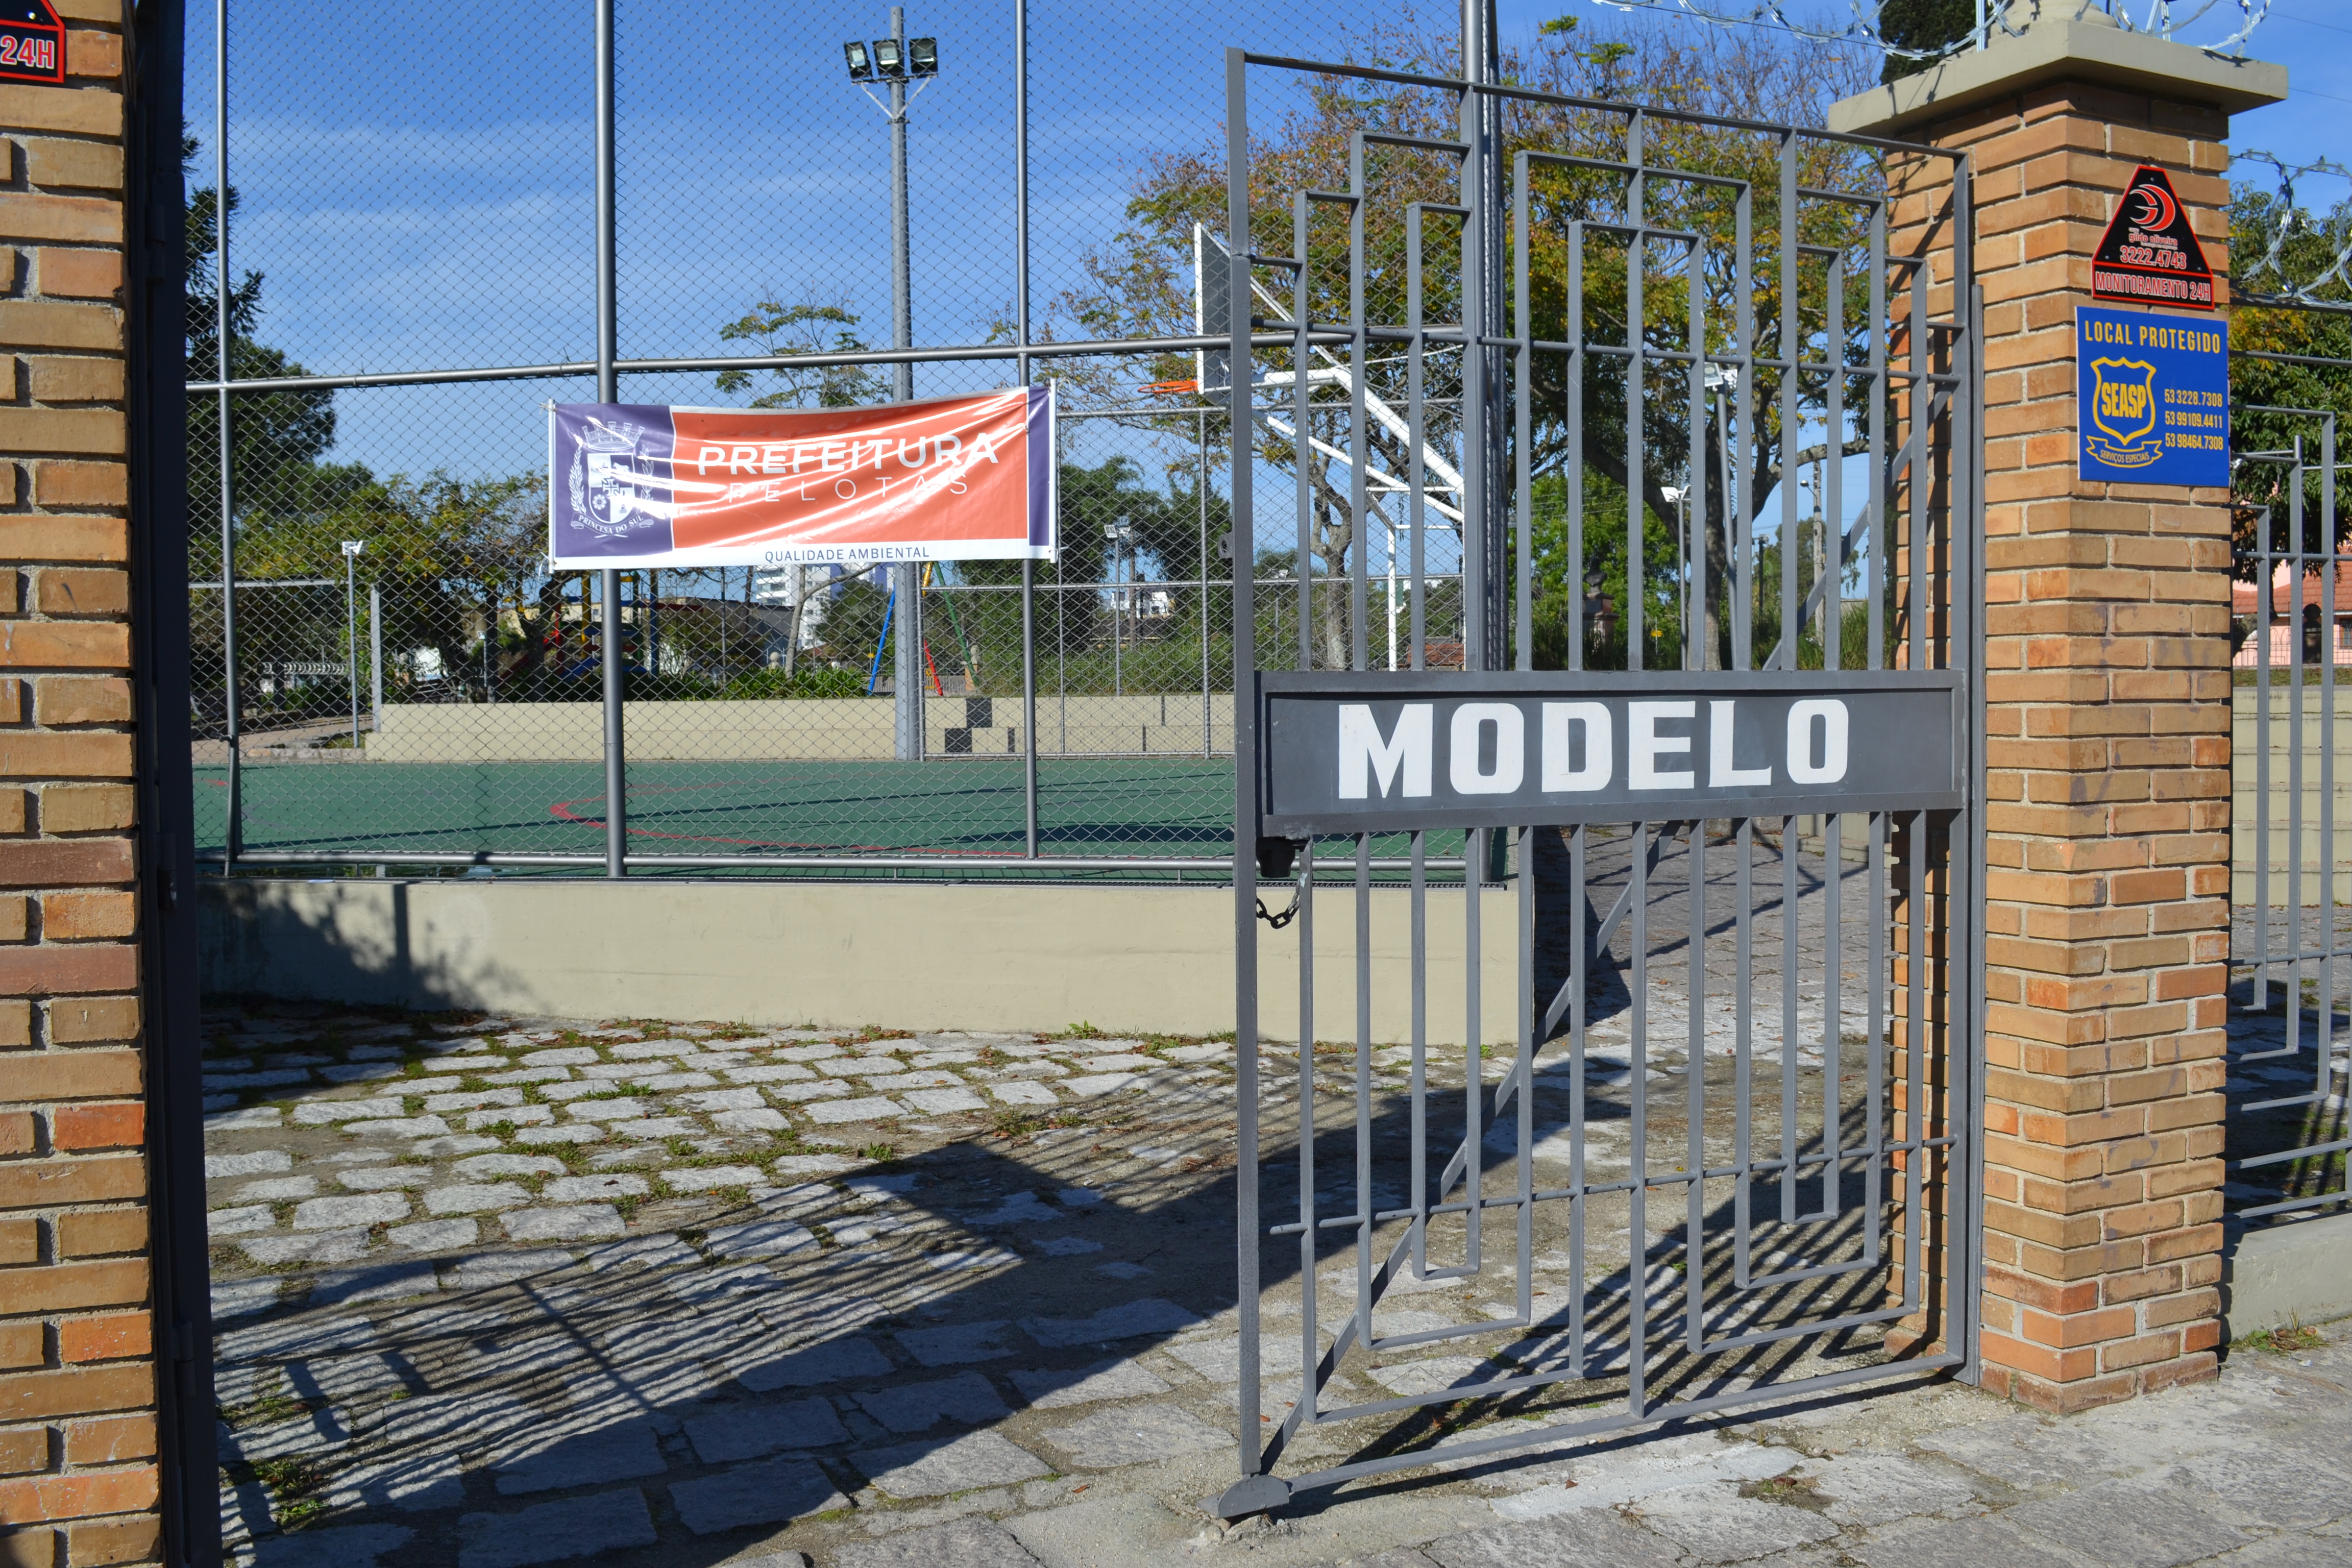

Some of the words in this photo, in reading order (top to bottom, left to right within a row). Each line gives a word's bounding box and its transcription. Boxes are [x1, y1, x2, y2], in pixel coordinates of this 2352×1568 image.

[0, 35, 55, 69] 24H
[2128, 232, 2148, 242] gildo
[2149, 234, 2178, 246] oliveira
[2120, 245, 2187, 270] 3222.4743
[2095, 271, 2188, 299] MONITORAMENTO
[2190, 281, 2211, 301] 24H
[2085, 320, 2133, 345] LOCAL
[2139, 325, 2221, 354] PROTEGIDO
[2101, 382, 2147, 419] SEASP
[2164, 388, 2174, 403] 53
[2176, 389, 2222, 407] 3228.7308
[2165, 411, 2175, 425] 53
[2177, 411, 2222, 429] 99109.4411
[698, 432, 999, 476] PREFEITURA
[2165, 433, 2175, 447] 53
[2177, 433, 2223, 450] 98464.7308
[2100, 449, 2124, 463] SERVIÇOS
[2125, 451, 2150, 463] ESPECIAIS
[729, 473, 968, 503] PELOTAS
[578, 514, 612, 534] PRINCESA
[615, 524, 627, 533] DO
[628, 514, 644, 527] SUL
[765, 549, 844, 564] QUALIDADE
[848, 546, 929, 559] AMBIENTAL
[1338, 699, 1849, 799] MODELO
